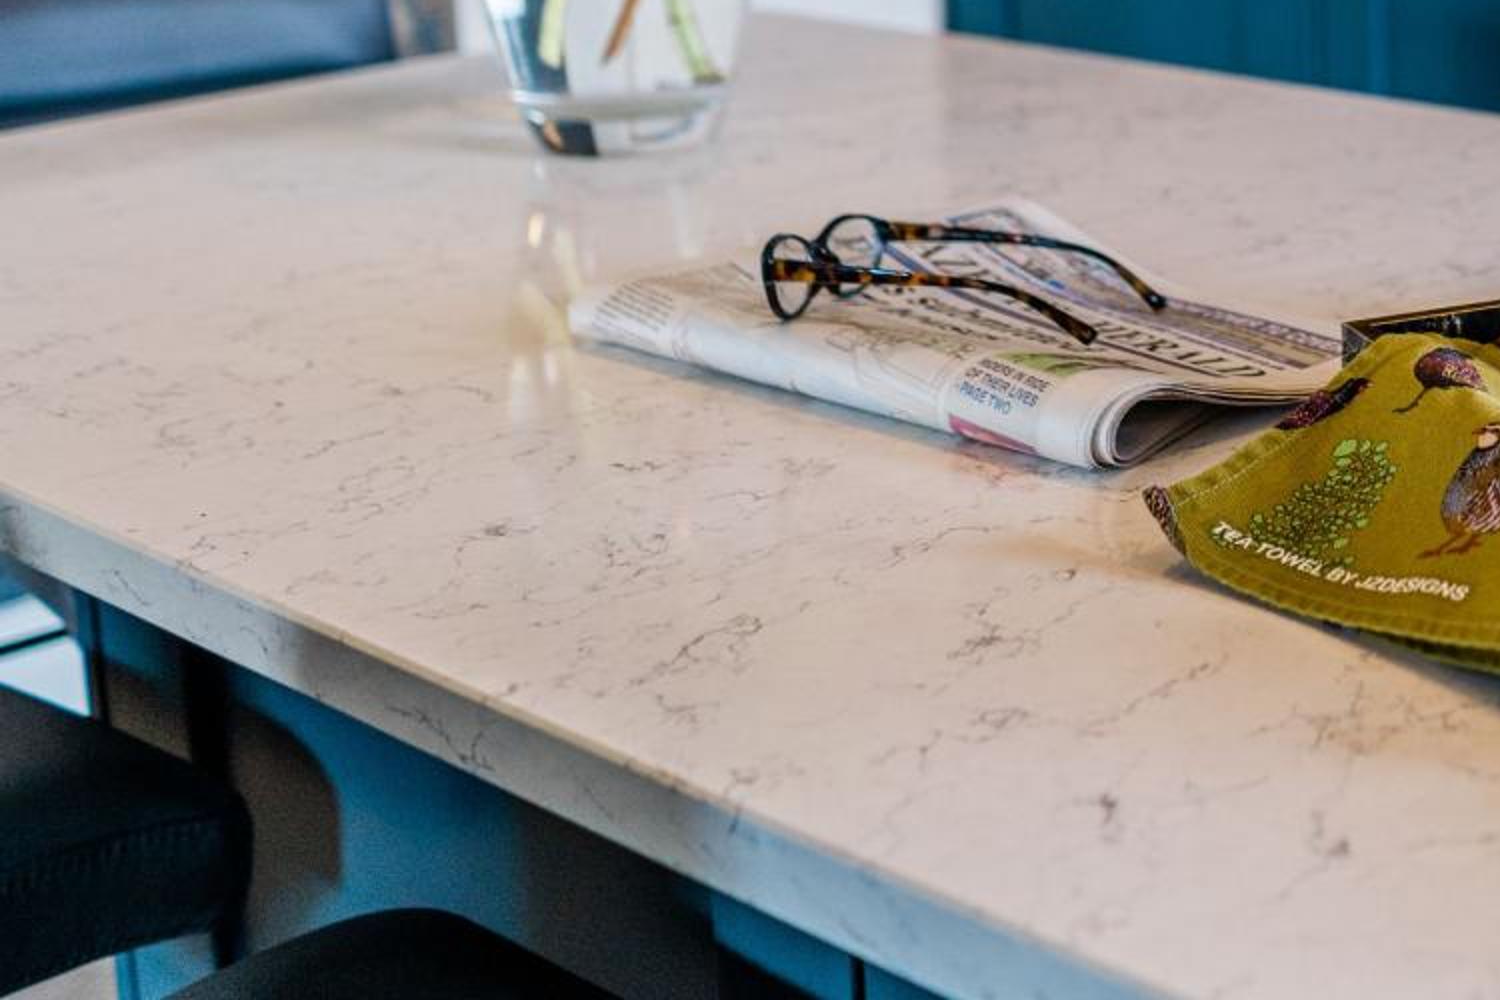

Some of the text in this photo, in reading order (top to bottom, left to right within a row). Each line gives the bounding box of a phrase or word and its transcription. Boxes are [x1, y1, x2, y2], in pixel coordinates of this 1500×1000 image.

[1093, 320, 1267, 377] HERALD
[1008, 386, 1039, 408] LIVES
[1212, 520, 1253, 550] TEA
[1255, 542, 1323, 578] TOWEL
[1325, 566, 1358, 586] BY
